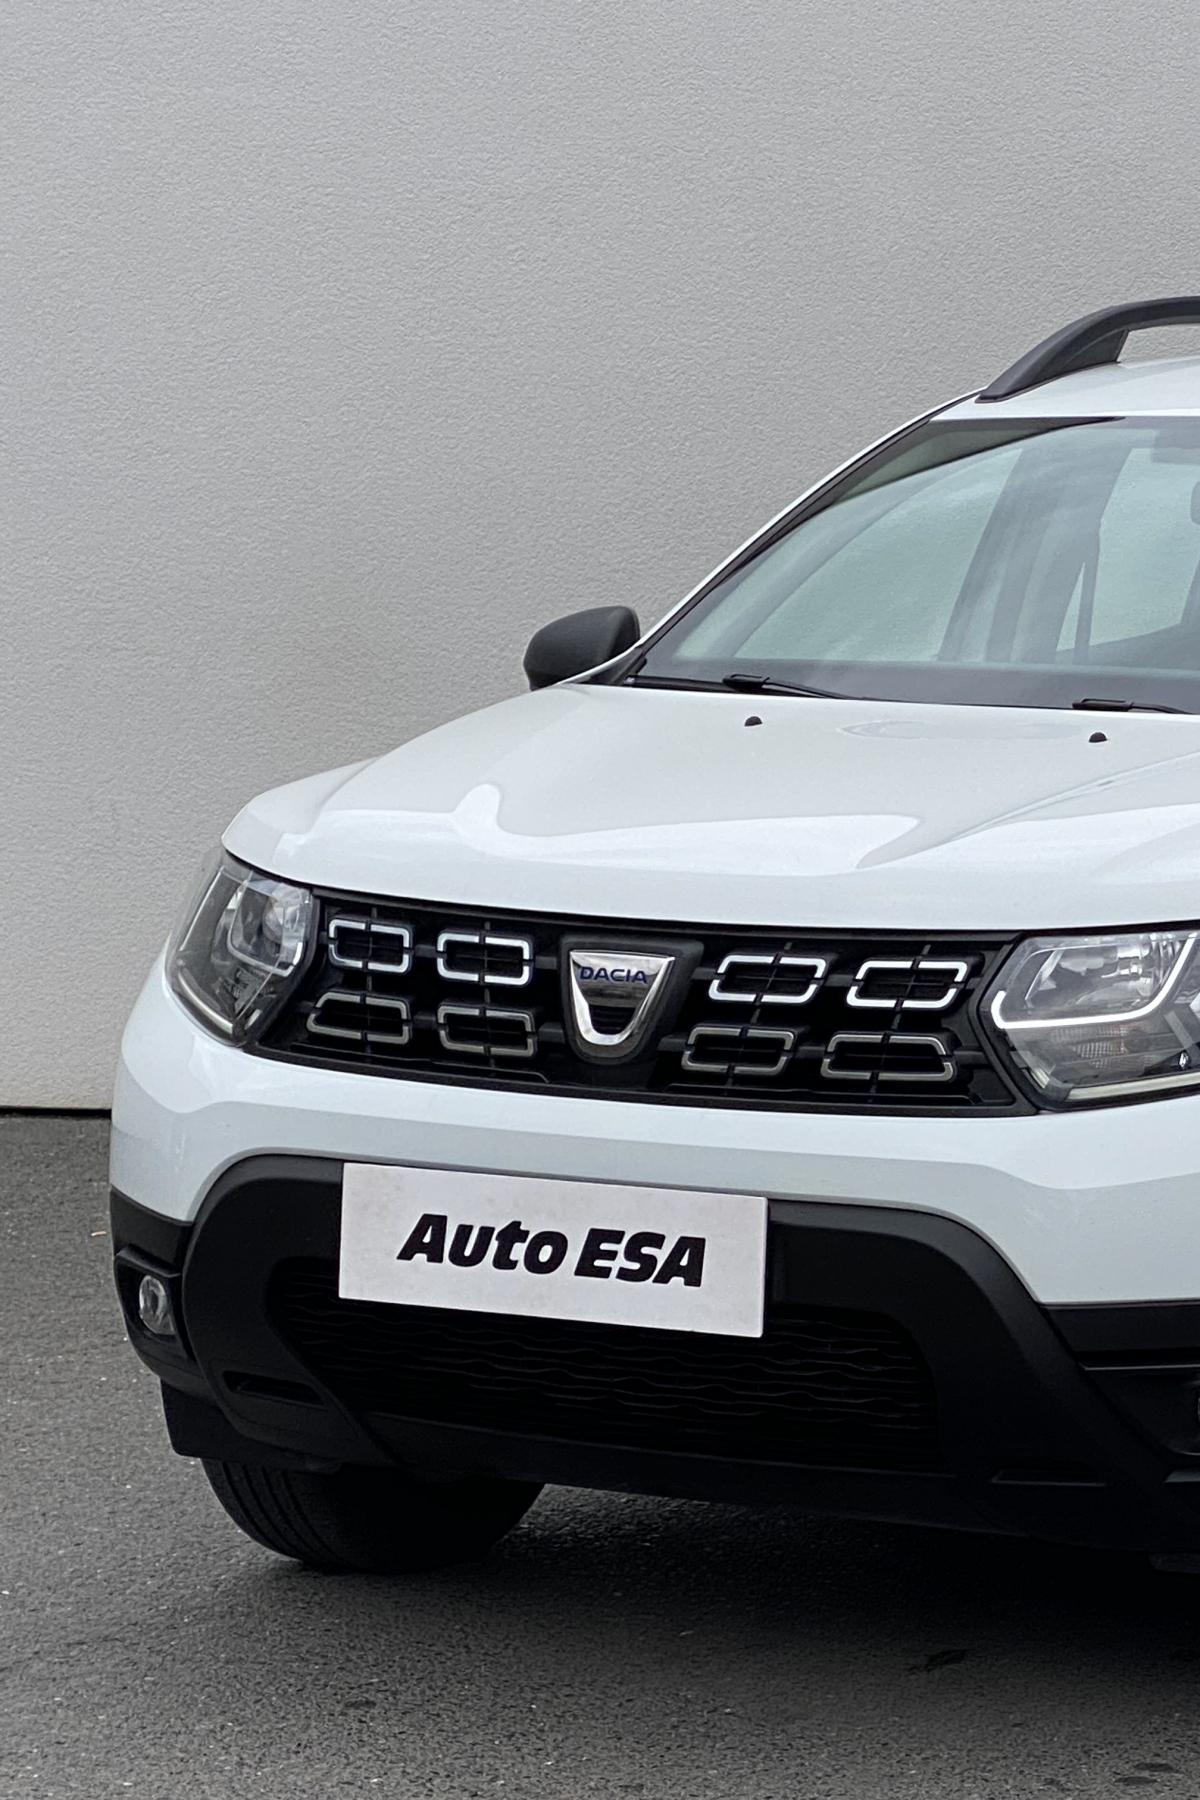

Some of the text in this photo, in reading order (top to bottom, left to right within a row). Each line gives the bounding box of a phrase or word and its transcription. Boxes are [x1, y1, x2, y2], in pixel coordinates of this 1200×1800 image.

[580, 966, 648, 984] DACIA
[396, 1213, 706, 1288] Auto ESA
